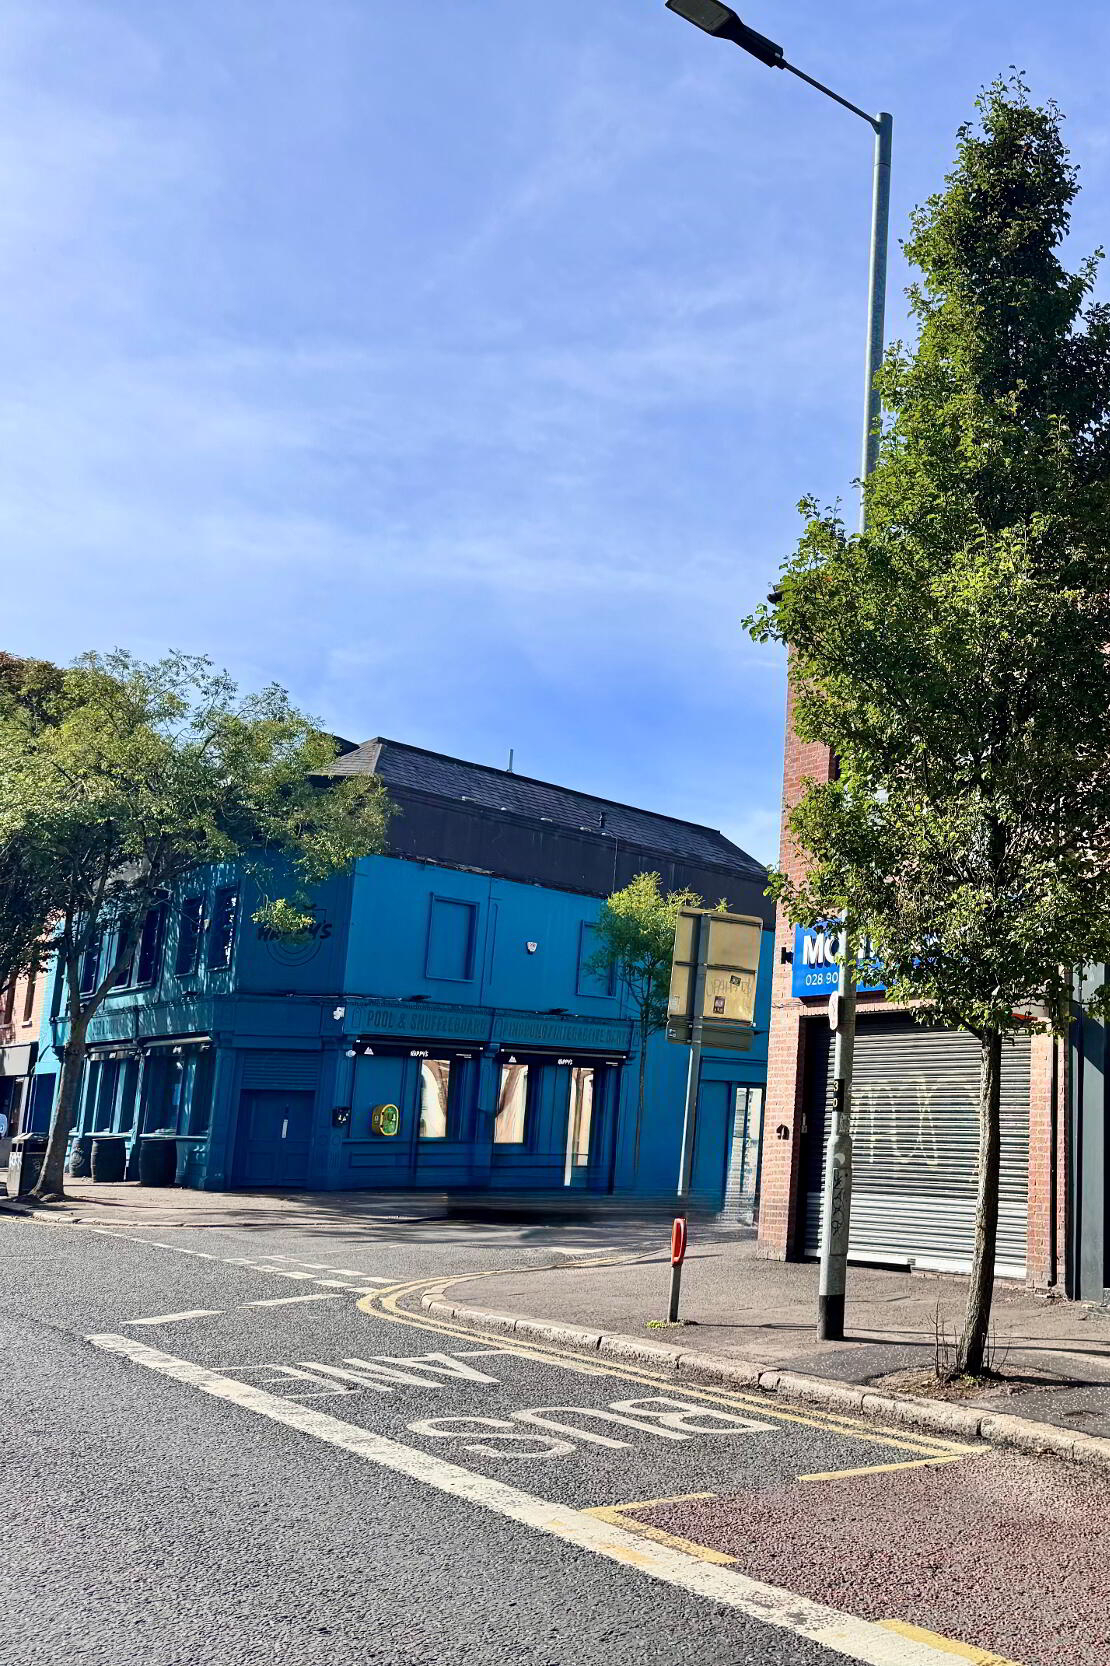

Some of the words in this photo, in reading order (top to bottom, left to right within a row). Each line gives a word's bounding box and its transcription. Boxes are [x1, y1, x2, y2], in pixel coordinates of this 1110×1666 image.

[805, 973, 823, 986] 028
[367, 1009, 393, 1029] POOL
[407, 1396, 781, 1459] BUS
